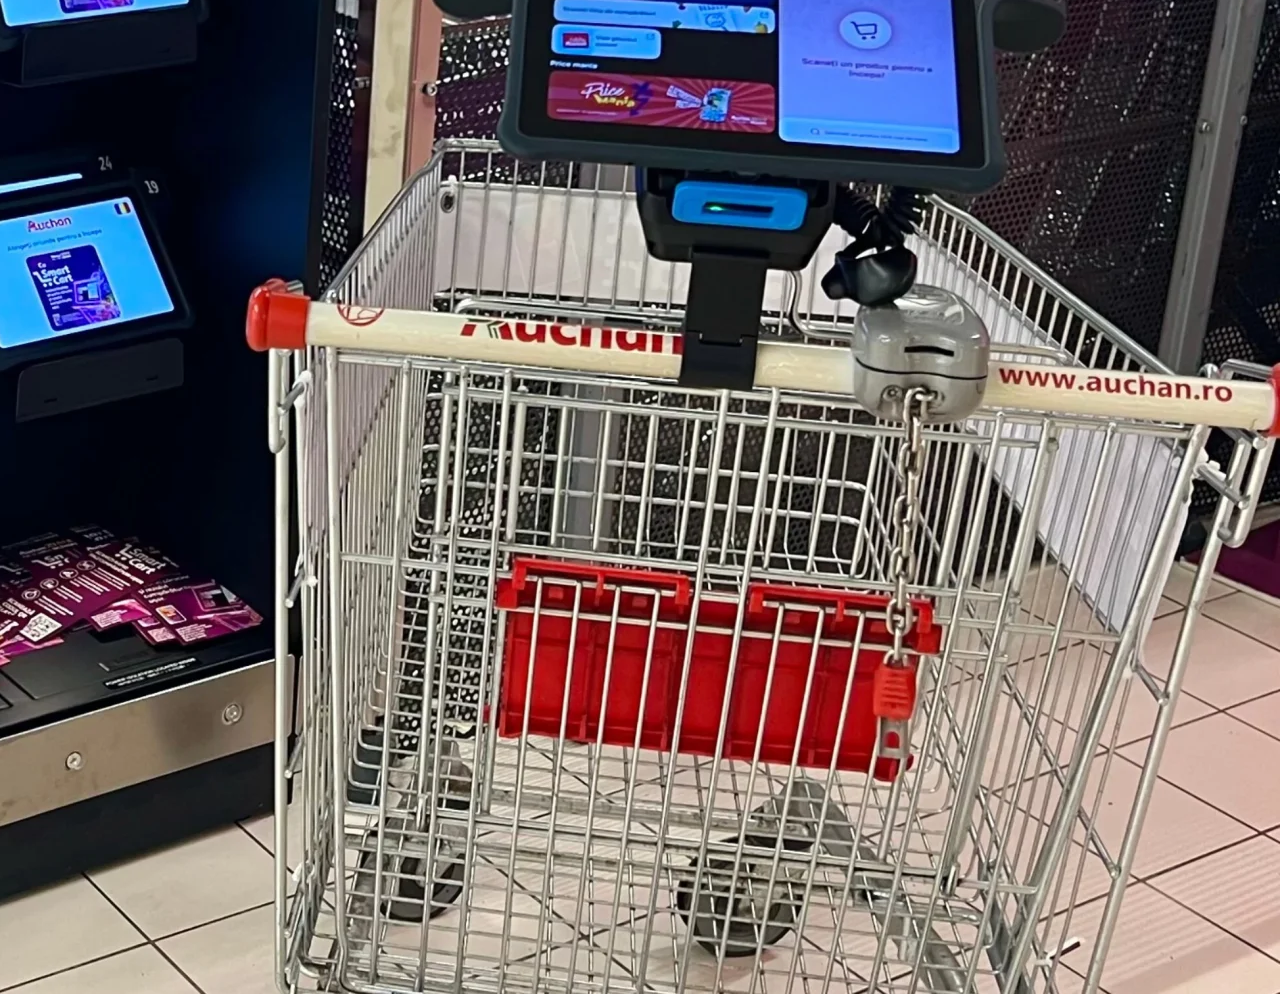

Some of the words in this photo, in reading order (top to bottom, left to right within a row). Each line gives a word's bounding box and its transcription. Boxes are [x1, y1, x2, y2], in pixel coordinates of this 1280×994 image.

[144, 180, 160, 194] 19
[27, 216, 72, 233] Auchan
[999, 366, 1233, 403] www.auchan.ro
